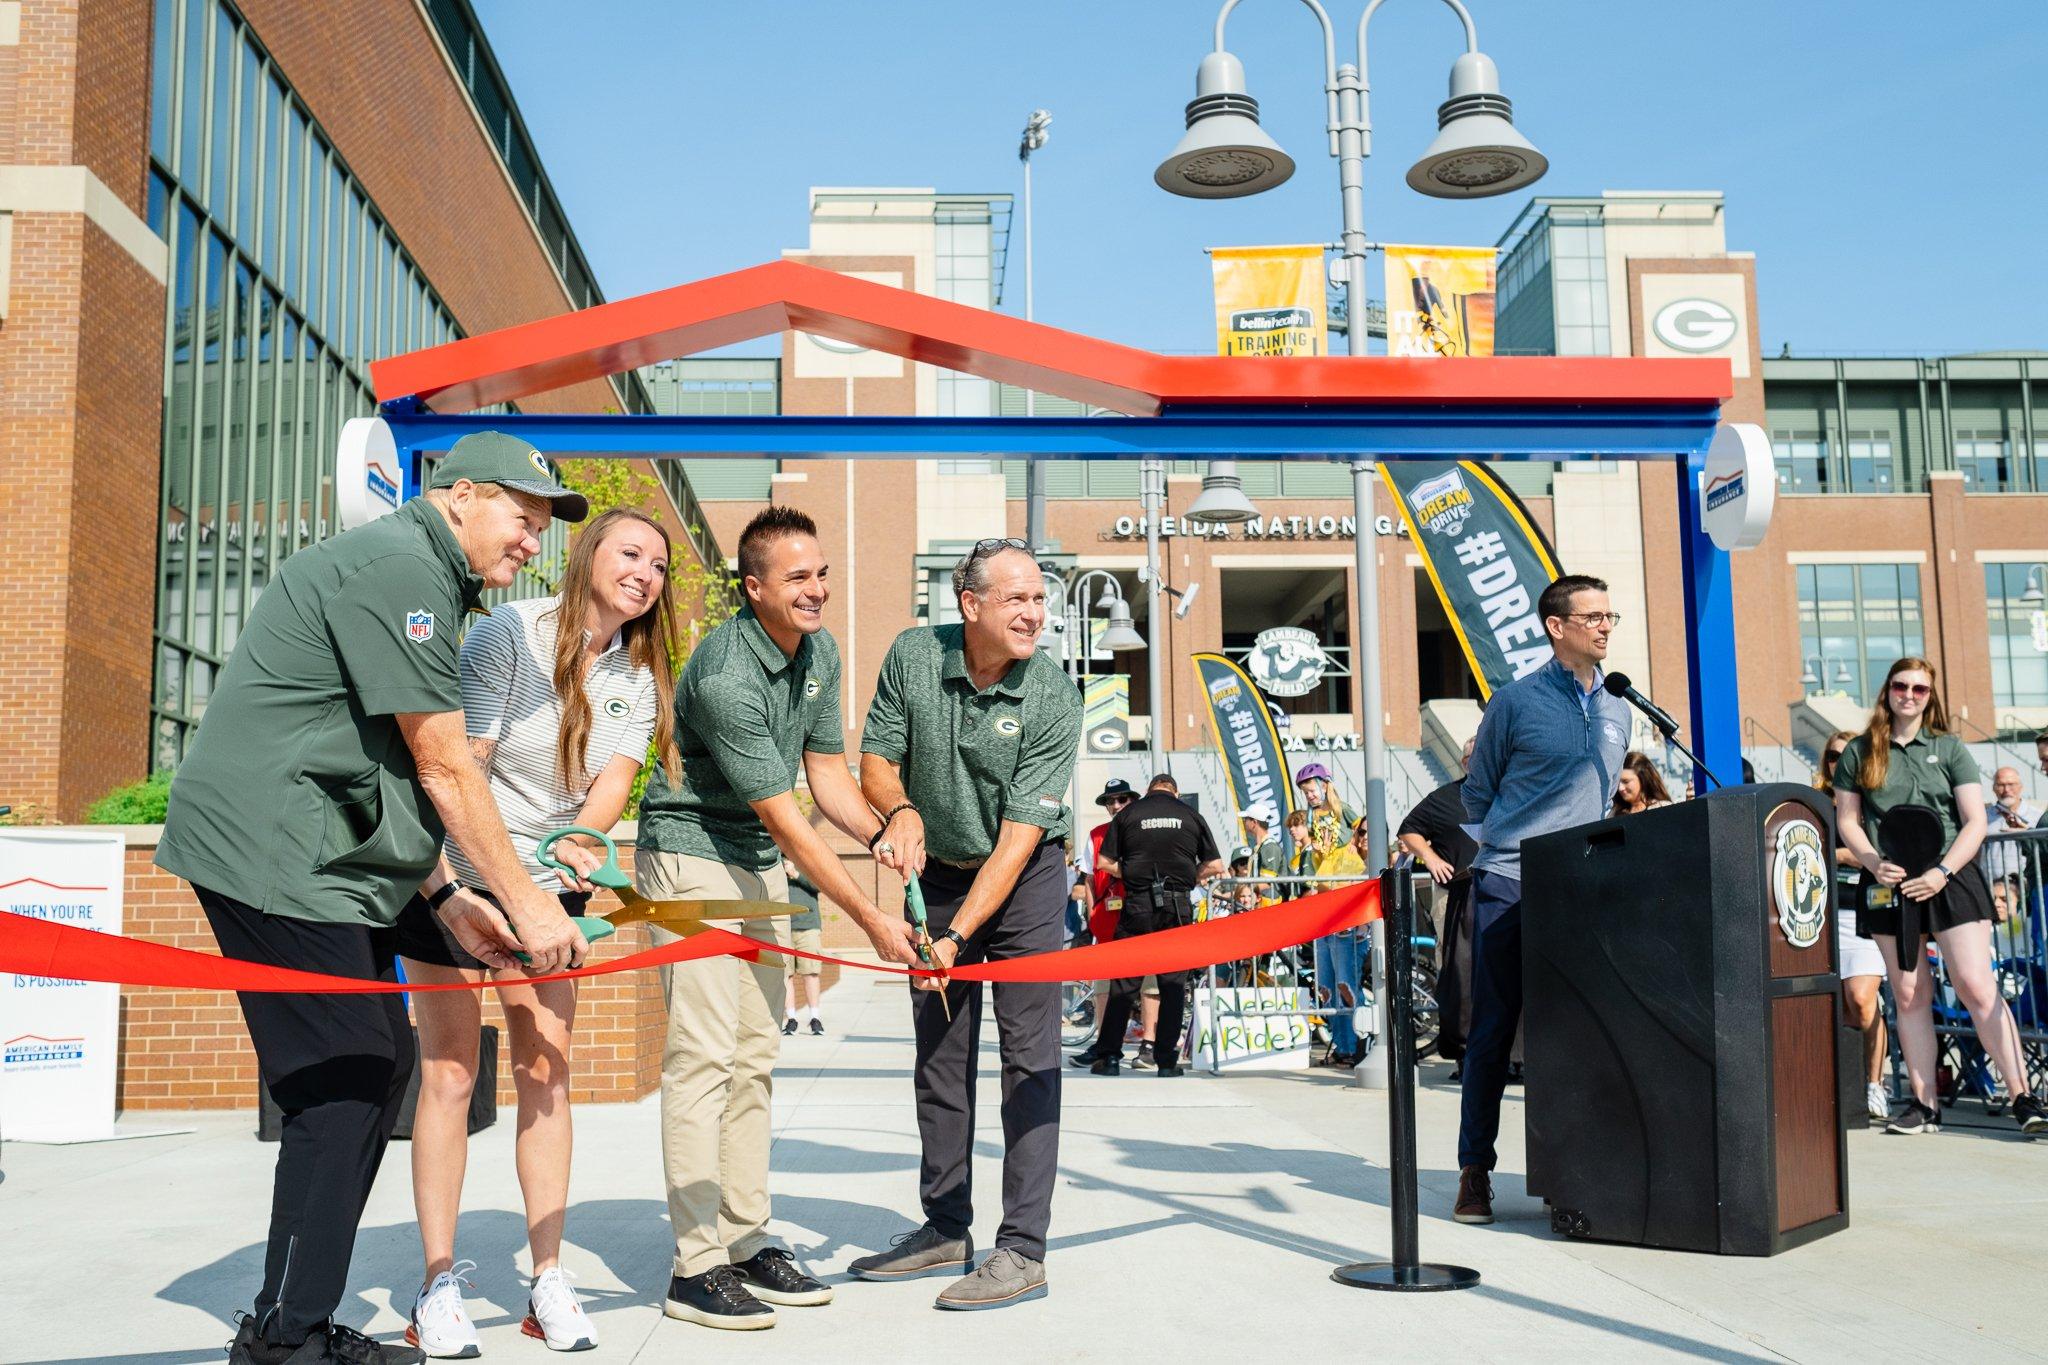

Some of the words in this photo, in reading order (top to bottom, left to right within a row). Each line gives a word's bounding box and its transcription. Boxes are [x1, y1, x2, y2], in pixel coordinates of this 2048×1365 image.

[1238, 332, 1307, 351] TRAINING
[1418, 487, 1473, 526] DREAM
[1247, 515, 1357, 536] NATION
[1430, 504, 1468, 532] DRIVE
[411, 624, 429, 636] NFL
[1271, 682, 1306, 694] FIELD
[1140, 817, 1182, 830] SECURITY
[1785, 825, 1818, 853] LAMBEAU
[11, 904, 47, 919] WHEN
[50, 904, 94, 919] YOU'RE
[1795, 921, 1817, 941] FIELD
[14, 974, 26, 988] IS
[1216, 991, 1297, 1012] Need
[1222, 1022, 1304, 1054] Ride?
[5, 1046, 49, 1054] AMERICAN
[52, 1043, 83, 1052] FAMILY
